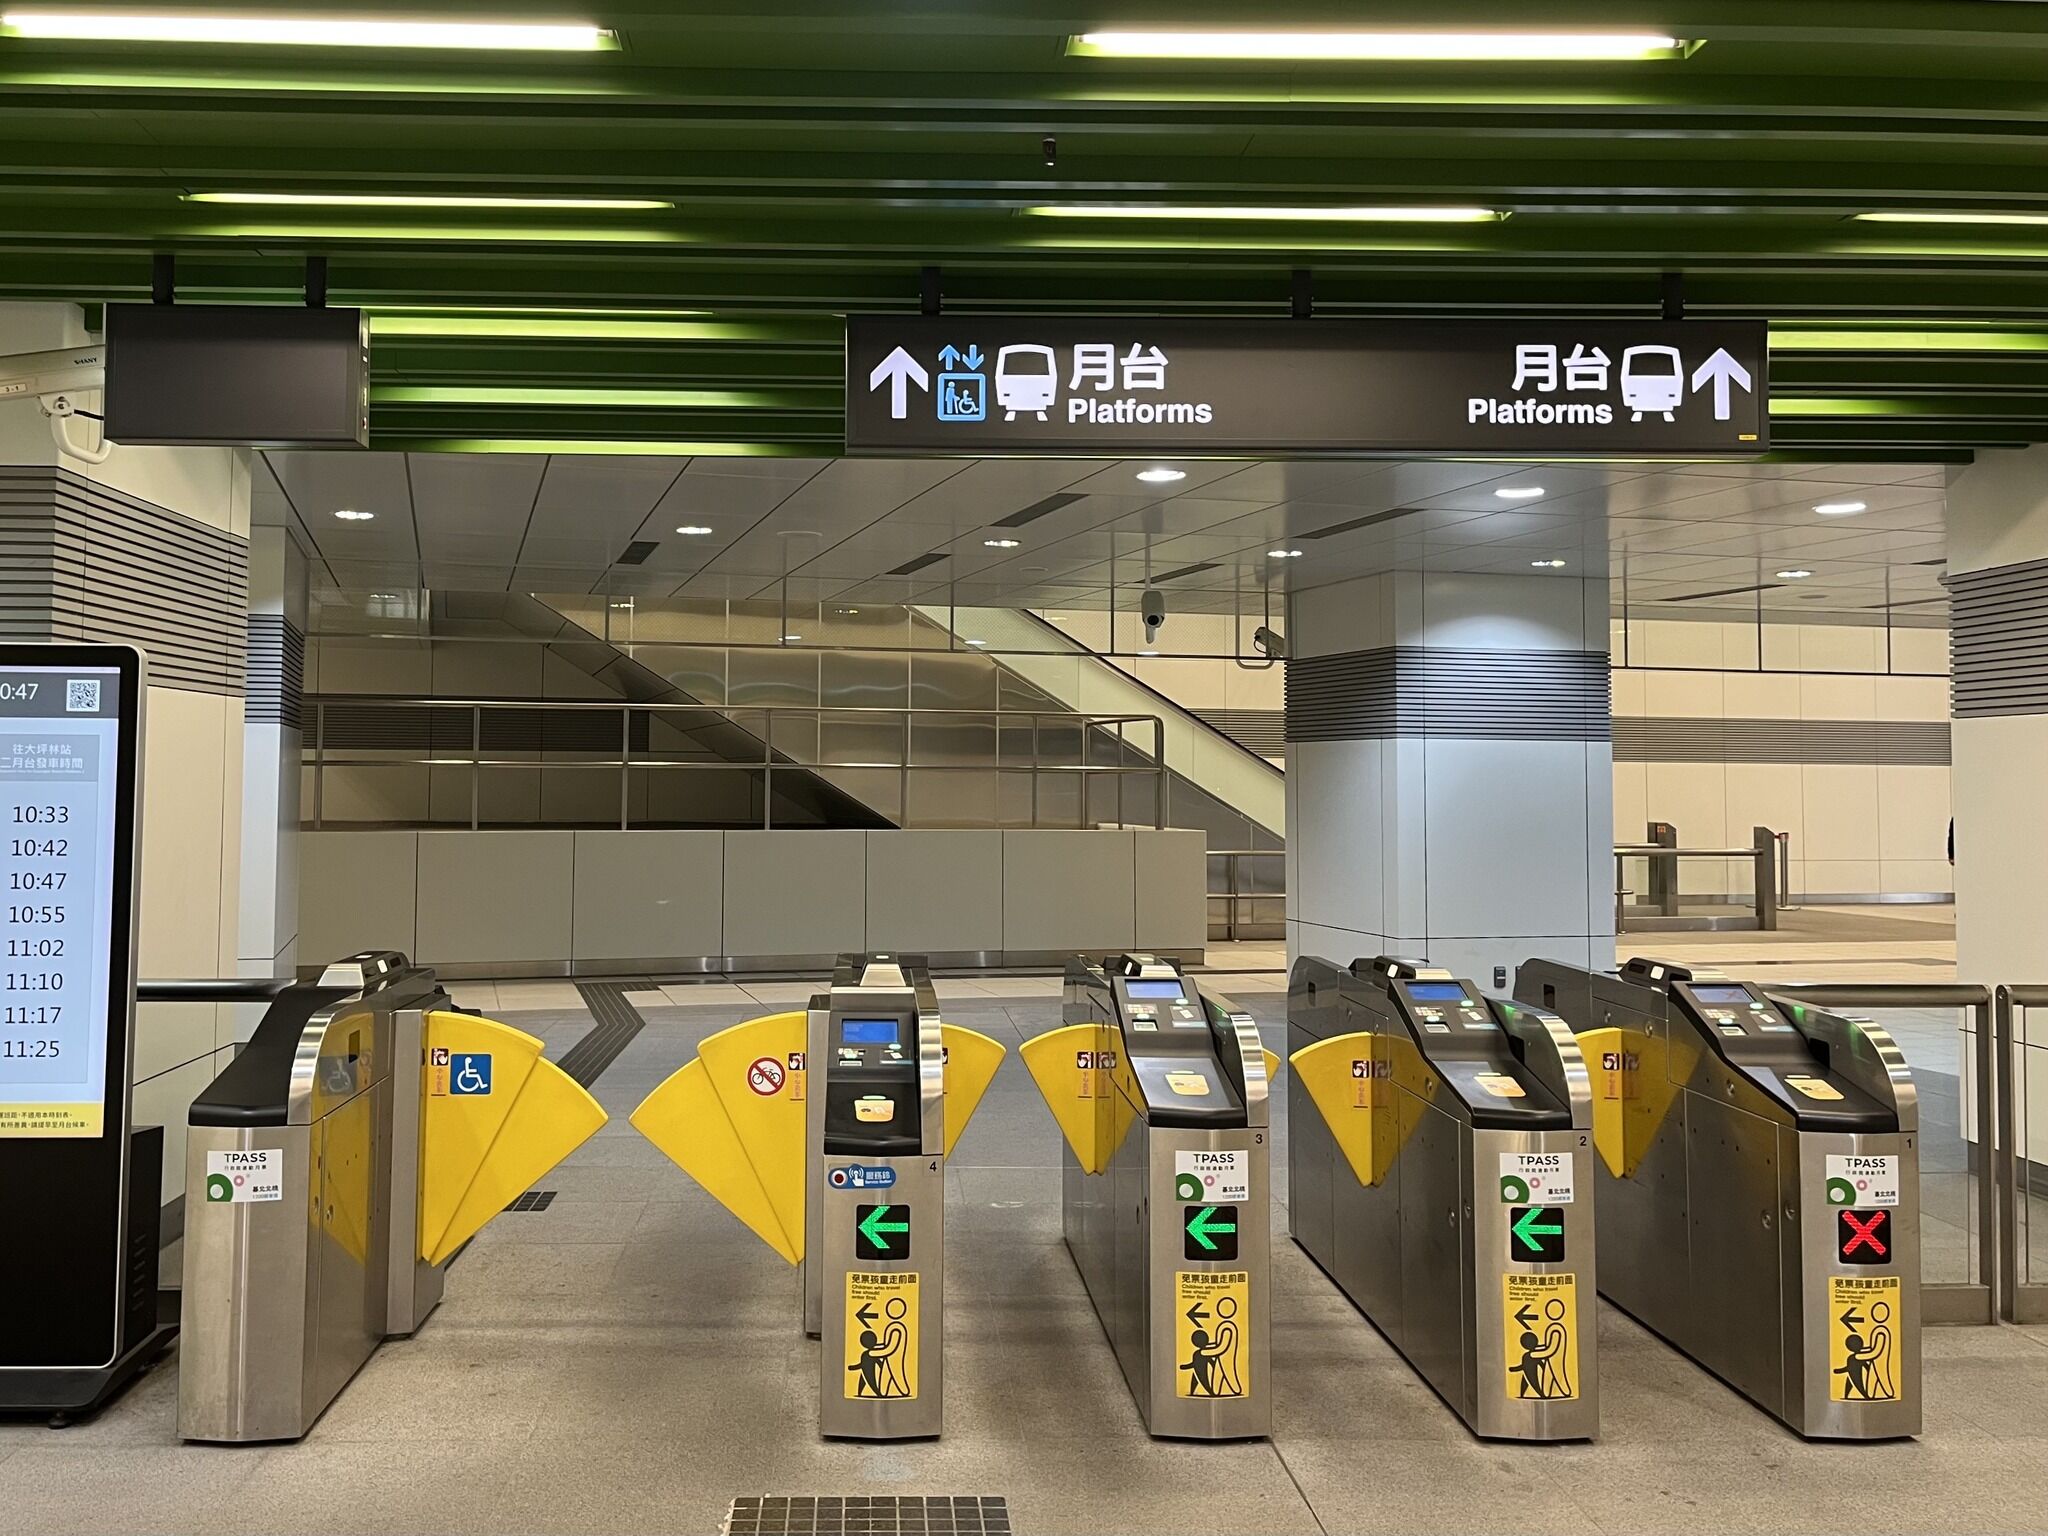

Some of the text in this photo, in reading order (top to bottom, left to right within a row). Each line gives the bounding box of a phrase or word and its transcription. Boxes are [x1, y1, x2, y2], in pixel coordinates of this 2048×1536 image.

[1068, 342, 1169, 391] 月台
[1511, 343, 1612, 392] 月台
[1068, 398, 1212, 425] Platforms
[1468, 398, 1613, 424] Platforms
[12, 743, 72, 755] 往大坪林站
[12, 806, 69, 824] 10:33
[11, 839, 69, 857] 10:42
[10, 872, 67, 890] 10:47
[9, 906, 65, 924] 10:55
[7, 939, 65, 957] 11:02
[6, 973, 63, 991] 11:10
[4, 1007, 62, 1024] 11:17
[3, 1040, 60, 1058] 11:25
[1255, 1134, 1263, 1144] 3
[1579, 1136, 1587, 1146] 2
[1906, 1138, 1912, 1148] 1
[224, 1152, 267, 1163] TPASS
[929, 1161, 937, 1172] 4
[1193, 1153, 1235, 1163] TPASS
[1518, 1155, 1560, 1165] TPASS
[1845, 1158, 1886, 1168] TPASS
